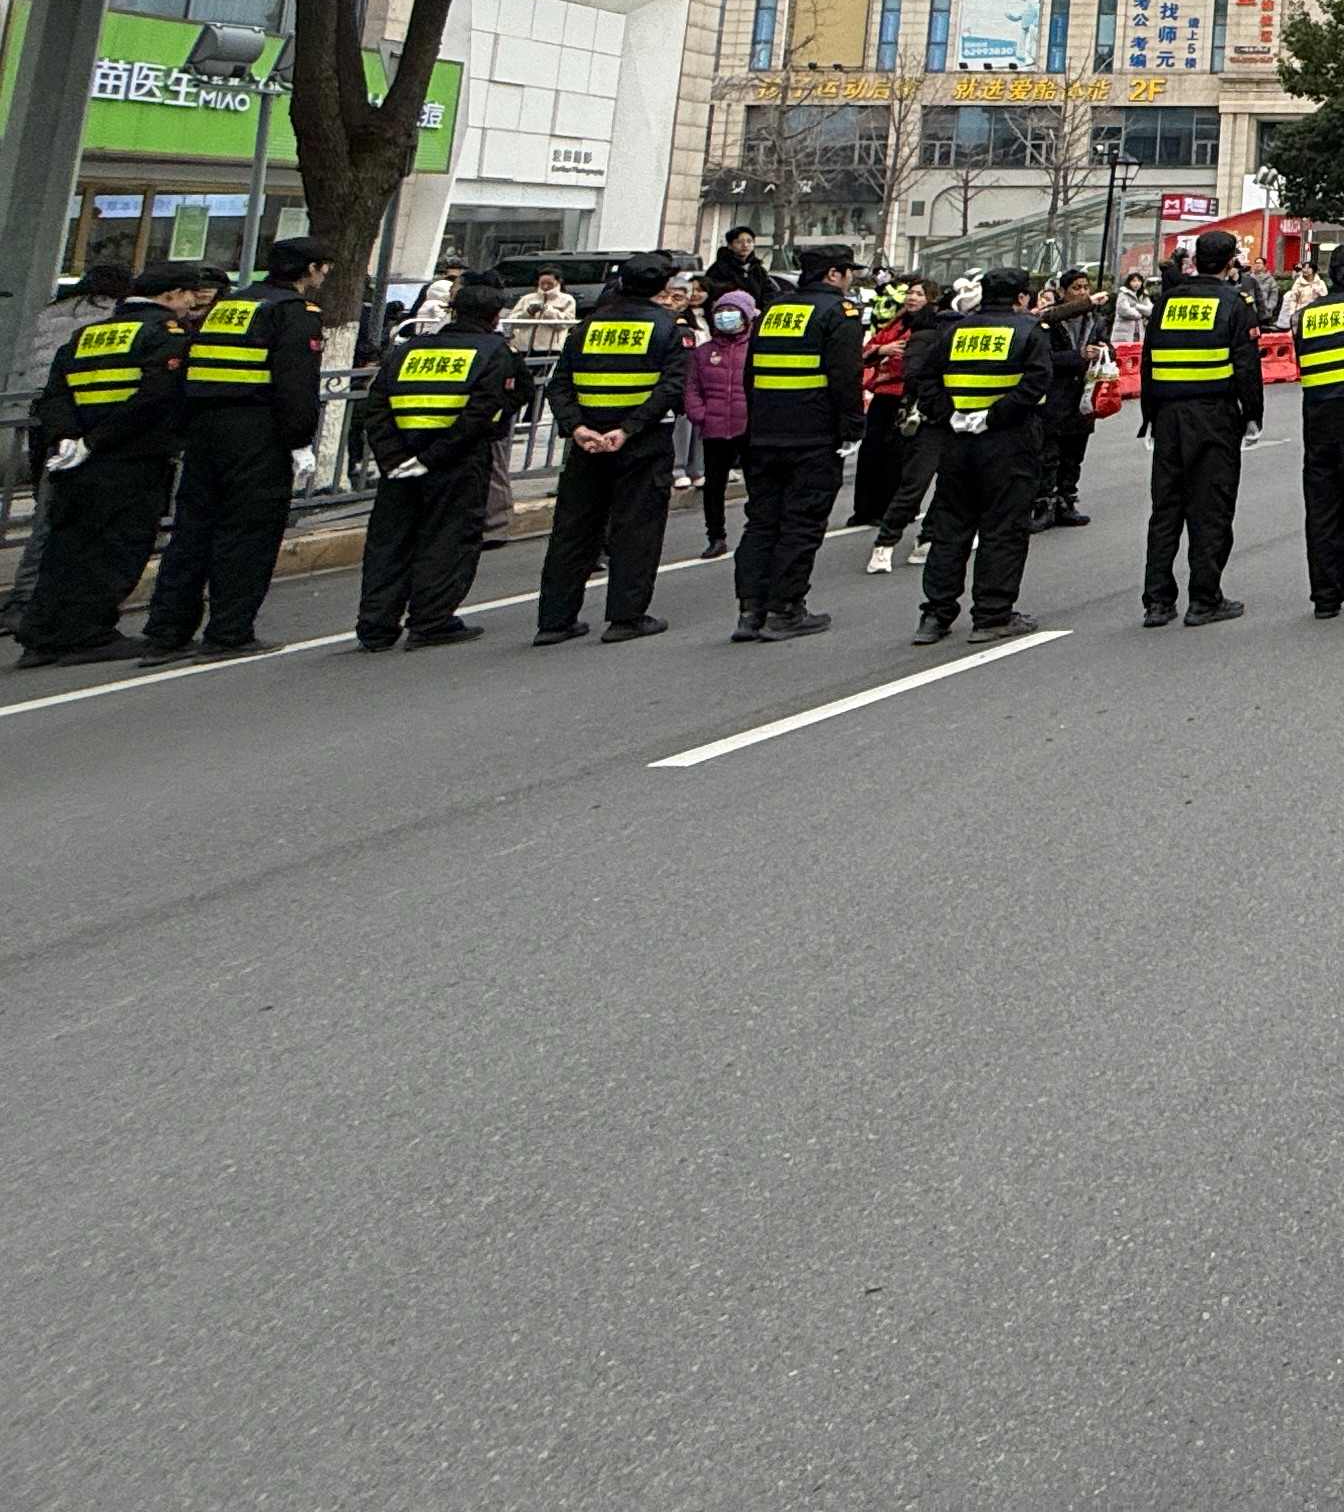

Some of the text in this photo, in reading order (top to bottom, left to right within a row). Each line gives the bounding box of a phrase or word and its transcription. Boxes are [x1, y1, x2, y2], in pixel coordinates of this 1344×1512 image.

[92, 58, 200, 108] 苗医生
[1128, 78, 1168, 102] 2F
[765, 312, 805, 331] 利邦保安
[1167, 305, 1213, 322] 利邦保安
[589, 329, 645, 347] 利邦保安
[955, 335, 1006, 353] 利邦保安
[406, 357, 466, 374] 利邦保安
